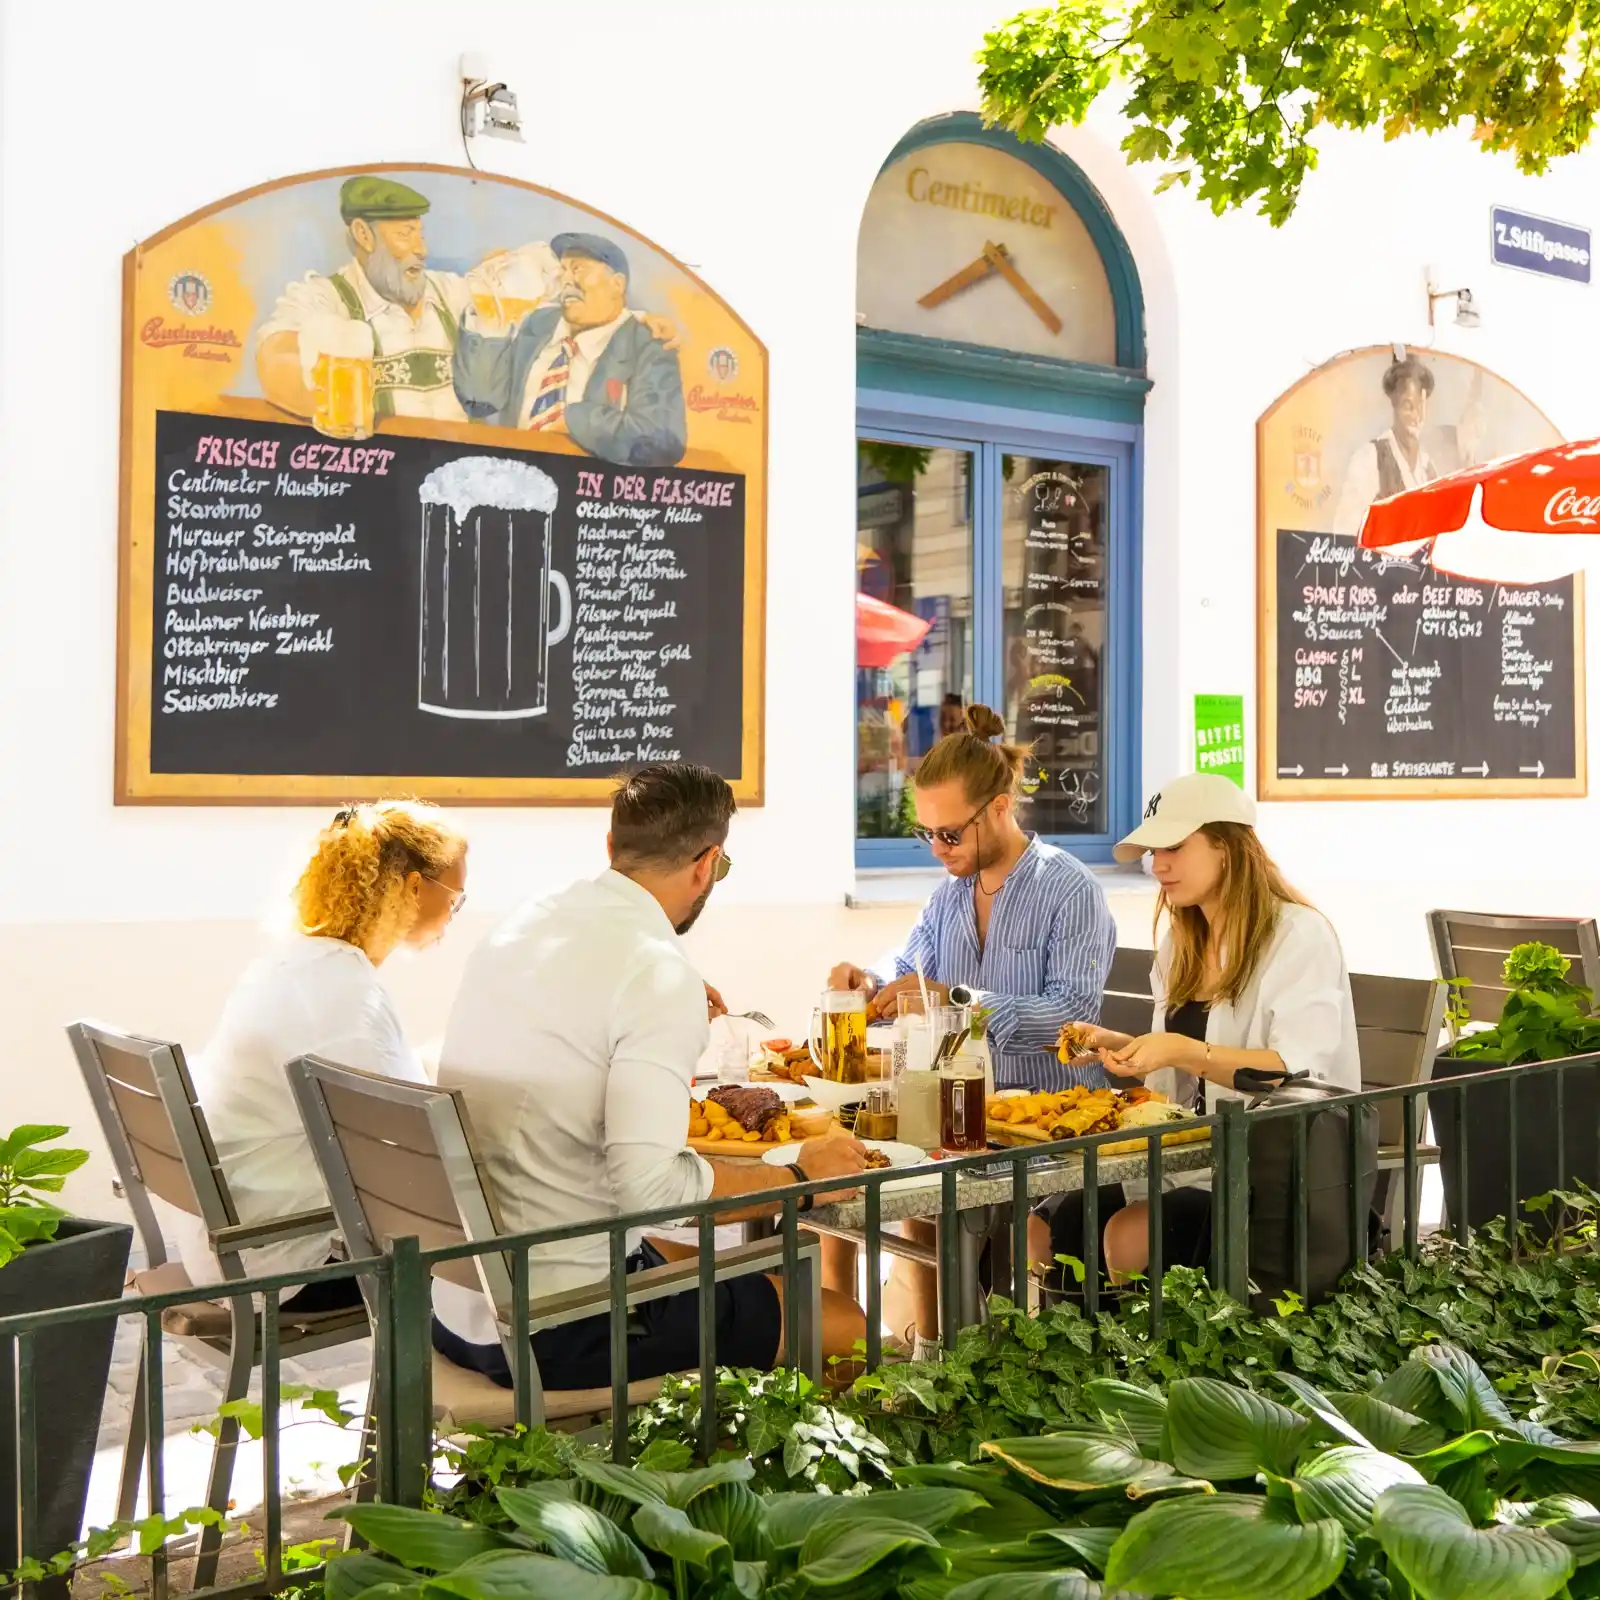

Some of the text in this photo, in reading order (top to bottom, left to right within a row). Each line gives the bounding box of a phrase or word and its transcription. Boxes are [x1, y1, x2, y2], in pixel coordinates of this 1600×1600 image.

[907, 168, 1058, 229] Centimeter
[195, 435, 395, 475] FRISCH GEZAPFT
[168, 469, 351, 496] Centimeter Hausbier
[576, 471, 735, 507] IN DER FLASCHE
[167, 496, 262, 519] Starobrno
[576, 501, 661, 528] Ottakringer
[169, 523, 245, 548] Murauer
[578, 523, 665, 541] Hadmar Bio
[576, 542, 676, 562] Hirter Märzen
[1306, 537, 1355, 577] Always
[1362, 549, 1372, 561] a
[166, 549, 371, 581] Hofbräuhaus Traunstein
[576, 560, 617, 585] Stiegl
[166, 577, 263, 605] Budweiser
[576, 582, 655, 601] Trumer Pils
[1303, 586, 1346, 605] SPARE
[1349, 585, 1377, 606] RIBS
[1392, 585, 1419, 604] oder
[1423, 585, 1453, 606] BEEF
[1455, 587, 1483, 606] RIBS
[1498, 586, 1541, 607] BURGER
[165, 609, 243, 633] Paulaner
[576, 601, 677, 627] Pilsner Urquell
[1292, 605, 1314, 622] mit
[574, 624, 654, 645] Puntigamer
[1319, 623, 1363, 639] Saucen
[164, 628, 334, 663] Ottakringer Zwickl
[659, 644, 691, 667] Gold
[1352, 648, 1363, 662] M
[164, 658, 249, 685] Mischbier
[1296, 667, 1322, 687] BBQ
[1352, 665, 1361, 680] L
[1392, 663, 1407, 684] auf
[162, 686, 278, 713] Saisonbiere
[578, 684, 627, 701] Corona
[1348, 686, 1365, 705] XL
[1389, 680, 1432, 697] auch mit
[572, 700, 616, 726] Stiegl
[1384, 698, 1431, 715] Cheddar
[572, 723, 673, 752] Guinness Dose
[1197, 724, 1241, 746] BITTE
[566, 743, 681, 767] Schneider Weisse
[1392, 761, 1456, 777] SPEISEKARTE
